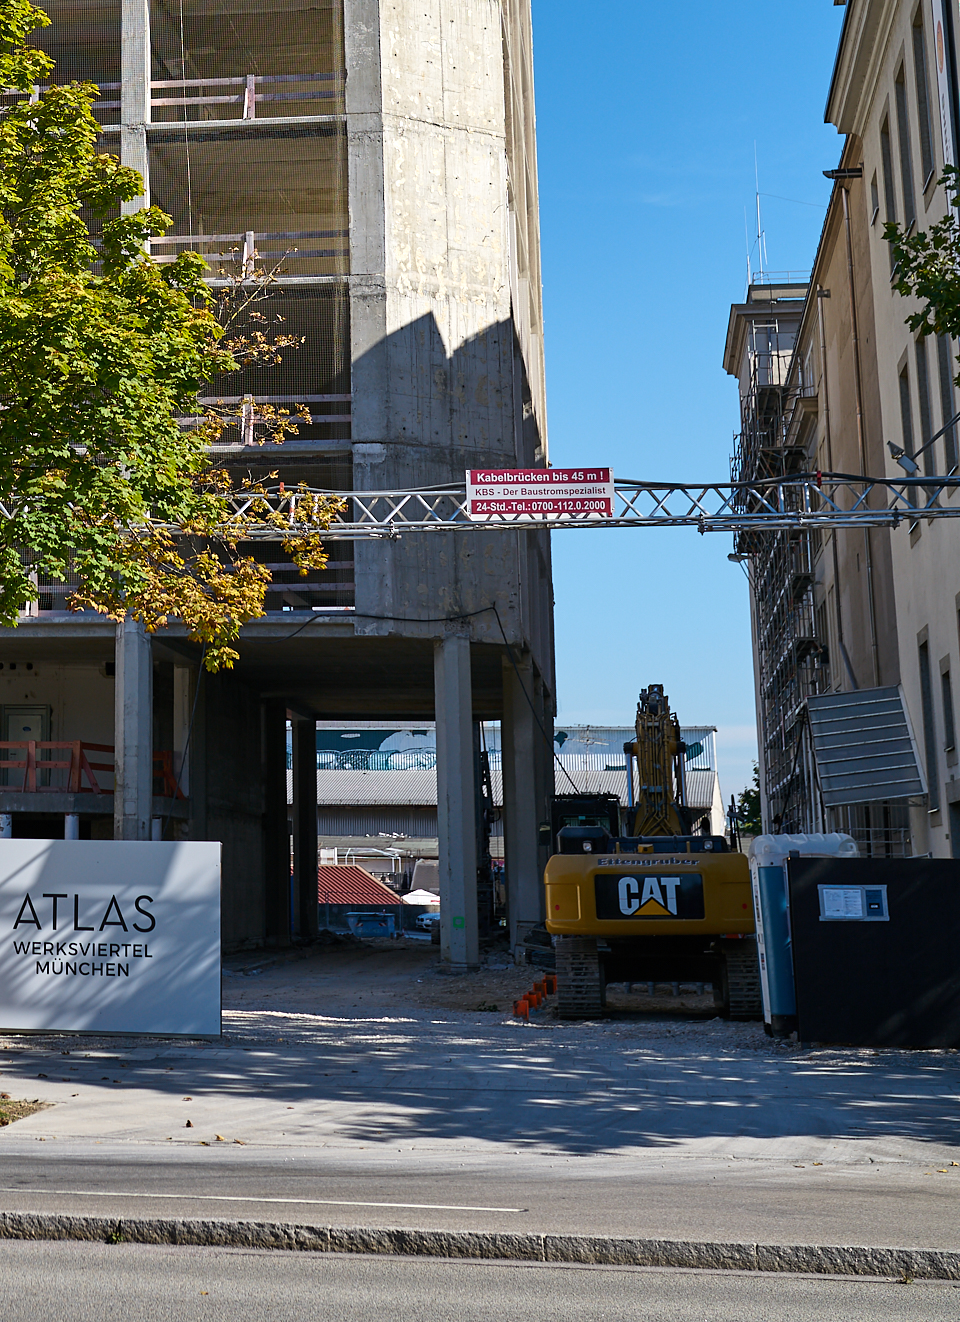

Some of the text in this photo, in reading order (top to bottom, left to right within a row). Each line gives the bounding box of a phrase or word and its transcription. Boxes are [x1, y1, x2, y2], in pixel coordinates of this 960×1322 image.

[476, 471, 550, 483] Kabelbrücken
[552, 471, 569, 482] bis
[571, 470, 586, 482] 45
[587, 472, 597, 481] m
[475, 488, 495, 496] KBS
[503, 488, 518, 496] Der
[521, 486, 606, 497] Baustromspezialist
[597, 857, 700, 867] Ettengruber
[617, 876, 681, 916] CAT
[12, 892, 156, 933] ATLAS
[13, 940, 153, 958] WERKSVIERTEL
[35, 957, 130, 977] MÜNCHEN
